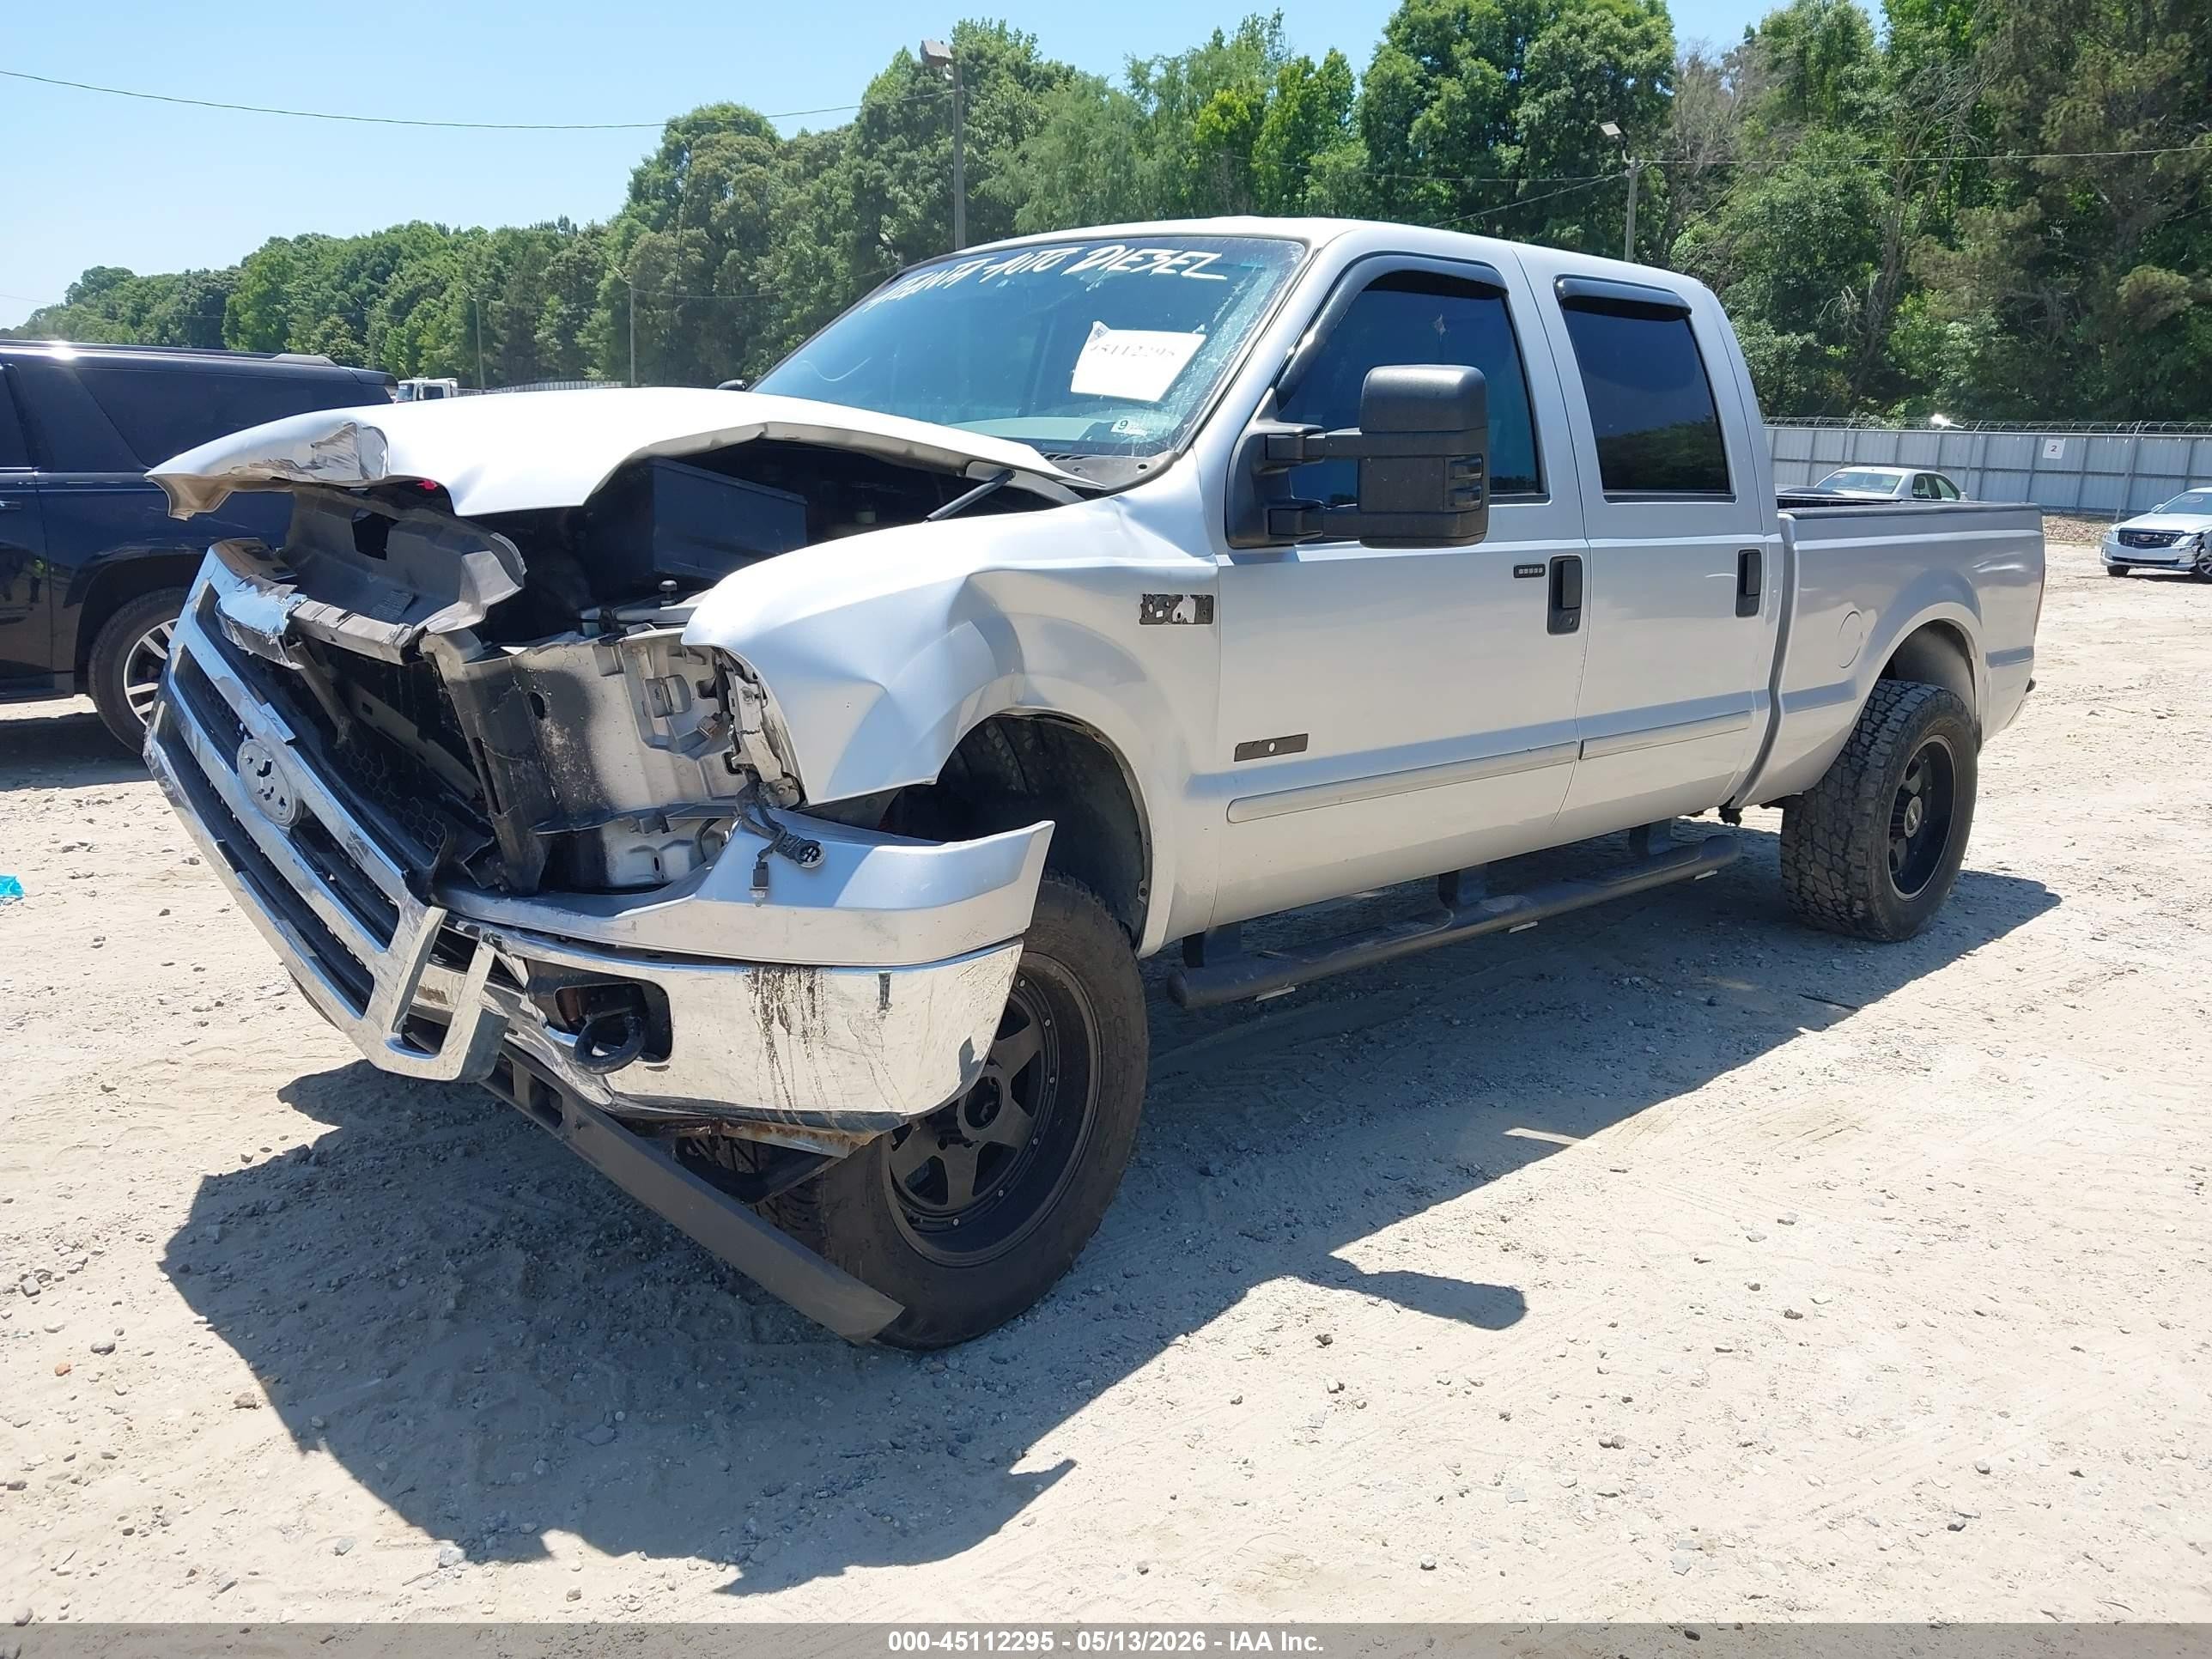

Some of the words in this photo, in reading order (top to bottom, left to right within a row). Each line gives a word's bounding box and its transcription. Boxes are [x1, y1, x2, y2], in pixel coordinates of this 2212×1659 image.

[978, 246, 1088, 283] AUTO
[1060, 244, 1228, 281] DIESEL
[1117, 419, 1128, 430] 9
